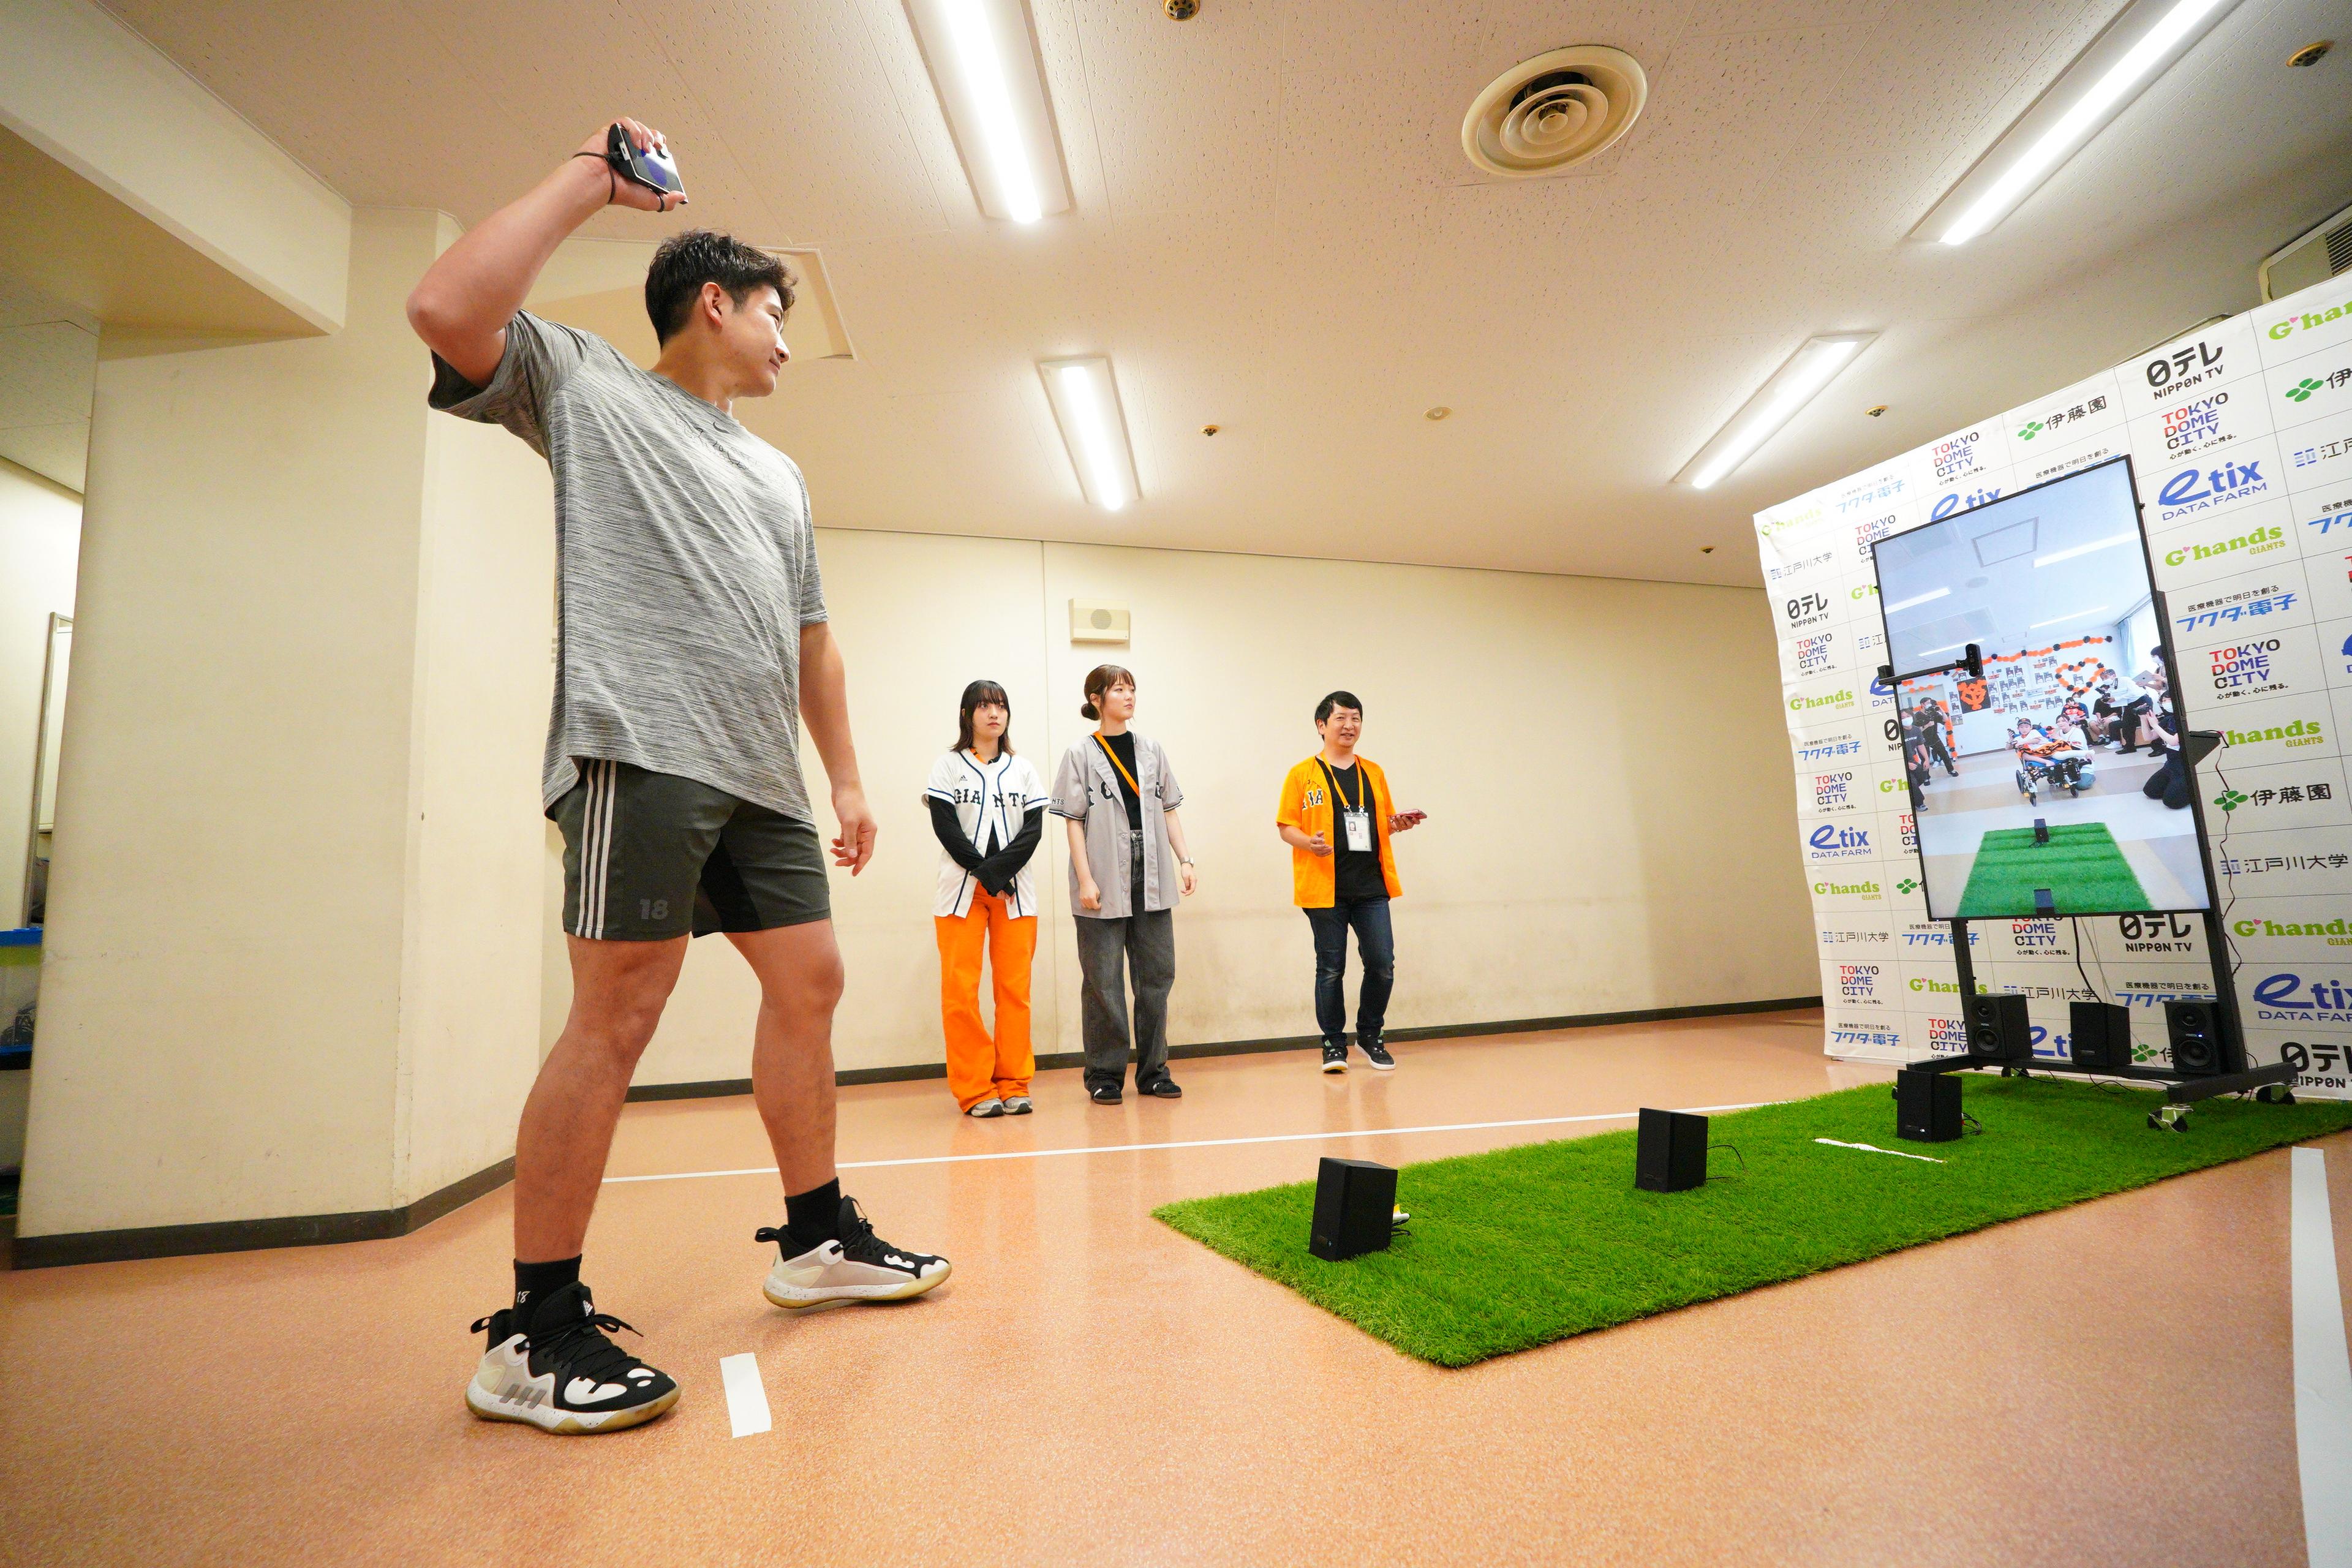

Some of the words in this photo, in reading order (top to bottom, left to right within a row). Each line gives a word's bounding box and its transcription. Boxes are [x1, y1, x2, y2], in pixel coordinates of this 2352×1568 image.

[2154, 373, 2202, 400] NIPPON
[2205, 364, 2224, 379] TV
[2046, 396, 2106, 430] 伊藤園
[2162, 392, 2228, 424] TOKYO
[2164, 409, 2218, 438] DOME
[1932, 432, 1980, 456] TOKYO
[2167, 422, 2219, 450] CITY
[2169, 433, 2237, 460] 心が動く、心に残る。
[1934, 445, 1973, 468] DOME
[2035, 448, 2109, 478] 医療機器で明日を創る
[1936, 456, 1973, 478] CITY
[2162, 500, 2210, 521] DATA
[2214, 482, 2267, 505] FARM
[1855, 514, 1896, 535] TOKYO
[1856, 527, 1891, 545] DOME
[2249, 540, 2286, 555] GIANTS
[1784, 552, 1832, 576] 江戸川大学
[2188, 584, 2279, 612] 医療機器で明日を創る
[2176, 592, 2297, 632] フクダ電子
[1791, 618, 1817, 629] NIPPON
[1819, 612, 1829, 623] TV
[1796, 633, 1832, 649] TOKYO
[1798, 644, 1827, 660] DOME
[2209, 639, 2280, 662] TOKYO
[1800, 654, 1828, 669] CITY
[2211, 655, 2269, 676] DOME
[2214, 669, 2270, 689] CITY
[2217, 683, 2288, 699] 心が動く、心に残る。
[1836, 701, 1855, 710] GIANTS
[1804, 734, 1852, 747] 医療機器で明日を創る
[2285, 736, 2324, 747] GIANTS
[1798, 741, 1861, 761] フクダ電子
[1815, 772, 1852, 785] TOKYO
[1816, 783, 1847, 795] DOME
[2250, 783, 2331, 806] 伊藤園
[1817, 793, 1847, 805] CITY
[1811, 850, 1839, 859] DATA
[1841, 848, 1872, 857] FARM
[2244, 854, 2348, 873] 江戸川大学
[639, 899, 669, 919] 18
[2012, 923, 2056, 933] DOME
[1835, 932, 1889, 943] 江戸川大学
[2015, 935, 2056, 946] CITY
[2125, 943, 2172, 952] NIPPON
[2174, 943, 2192, 952] TV
[1839, 965, 1879, 975] TOKYO
[1841, 976, 1872, 986] DOME
[2125, 982, 2209, 990] 医療機器で明日を創る
[1842, 987, 1873, 995] CITY
[2258, 1010, 2313, 1021] DATA
[1831, 1031, 1901, 1046] フクダ電子
[1929, 1030, 1967, 1041] DOME
[1931, 1041, 1967, 1052] CITY
[2300, 1076, 2346, 1088] IPPON
[517, 1291, 530, 1303] 18
